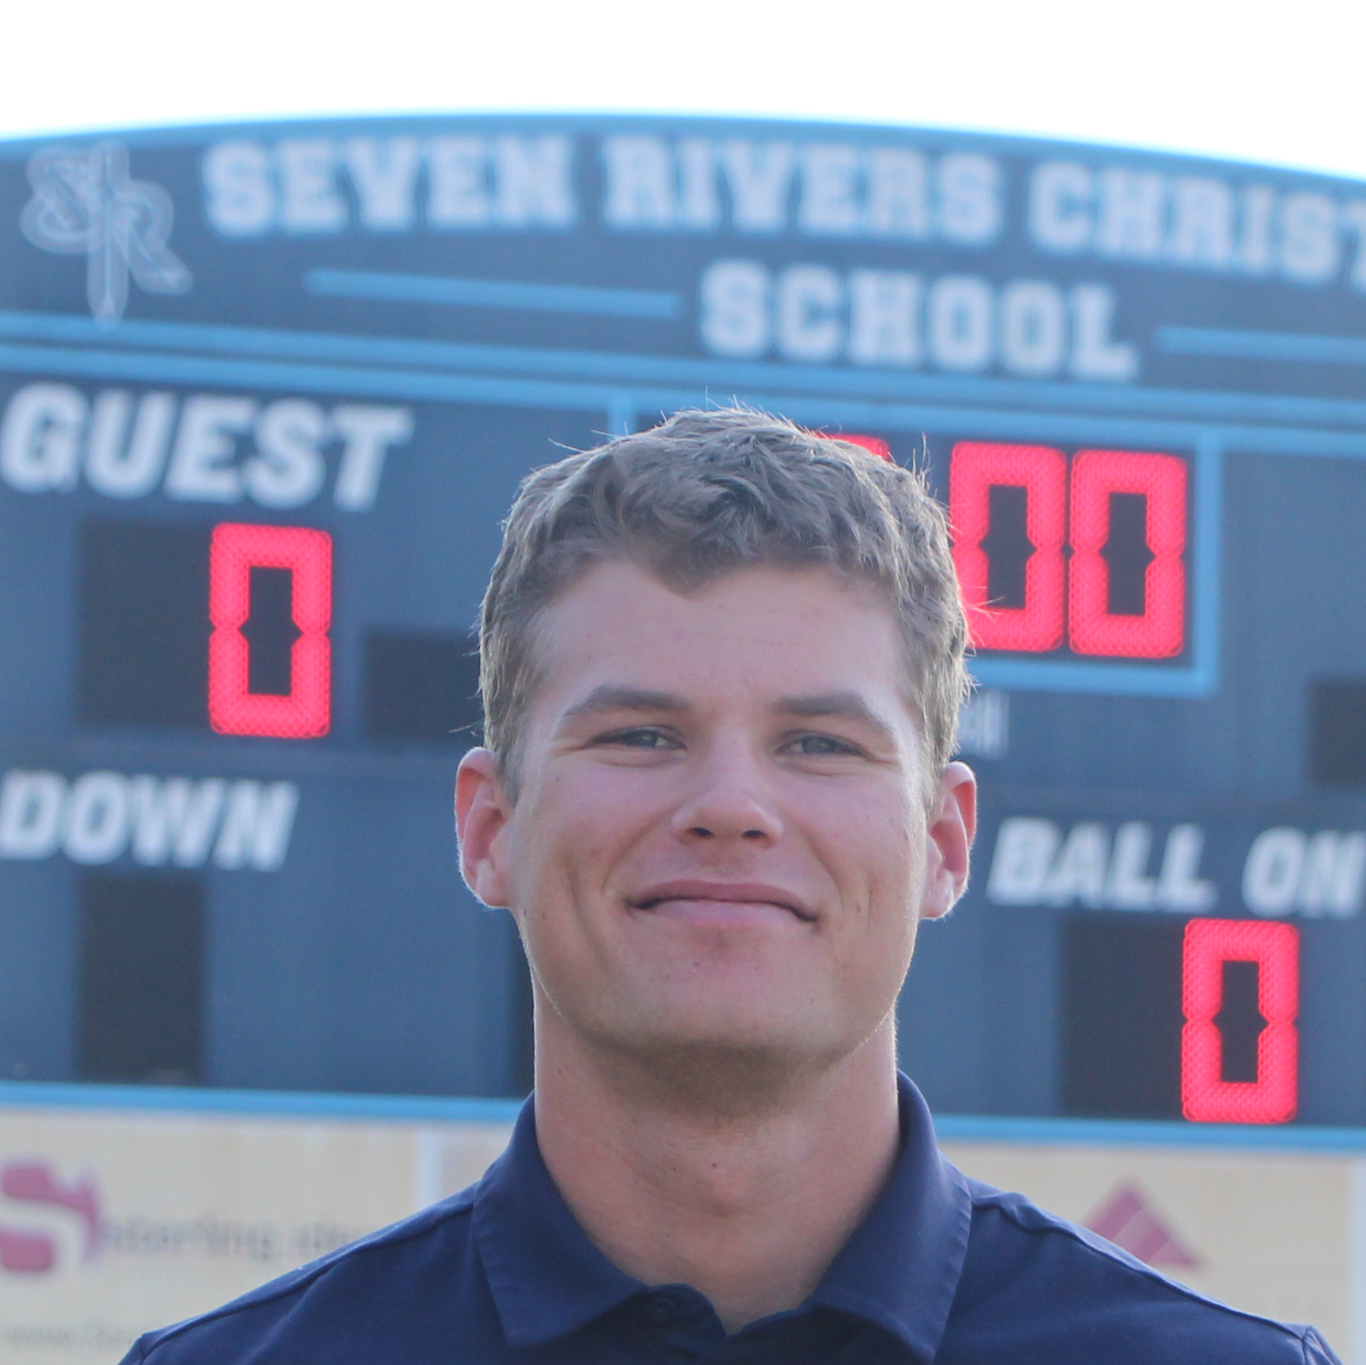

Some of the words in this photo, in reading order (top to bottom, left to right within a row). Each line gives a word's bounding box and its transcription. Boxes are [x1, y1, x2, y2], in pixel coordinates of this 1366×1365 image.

[201, 133, 575, 239] SEVEN
[600, 133, 1005, 248] RIVERS
[697, 257, 1139, 383] SCHOOL
[208, 521, 333, 739] 0
[985, 815, 1221, 912] BALL
[1180, 917, 1300, 1125] 0
